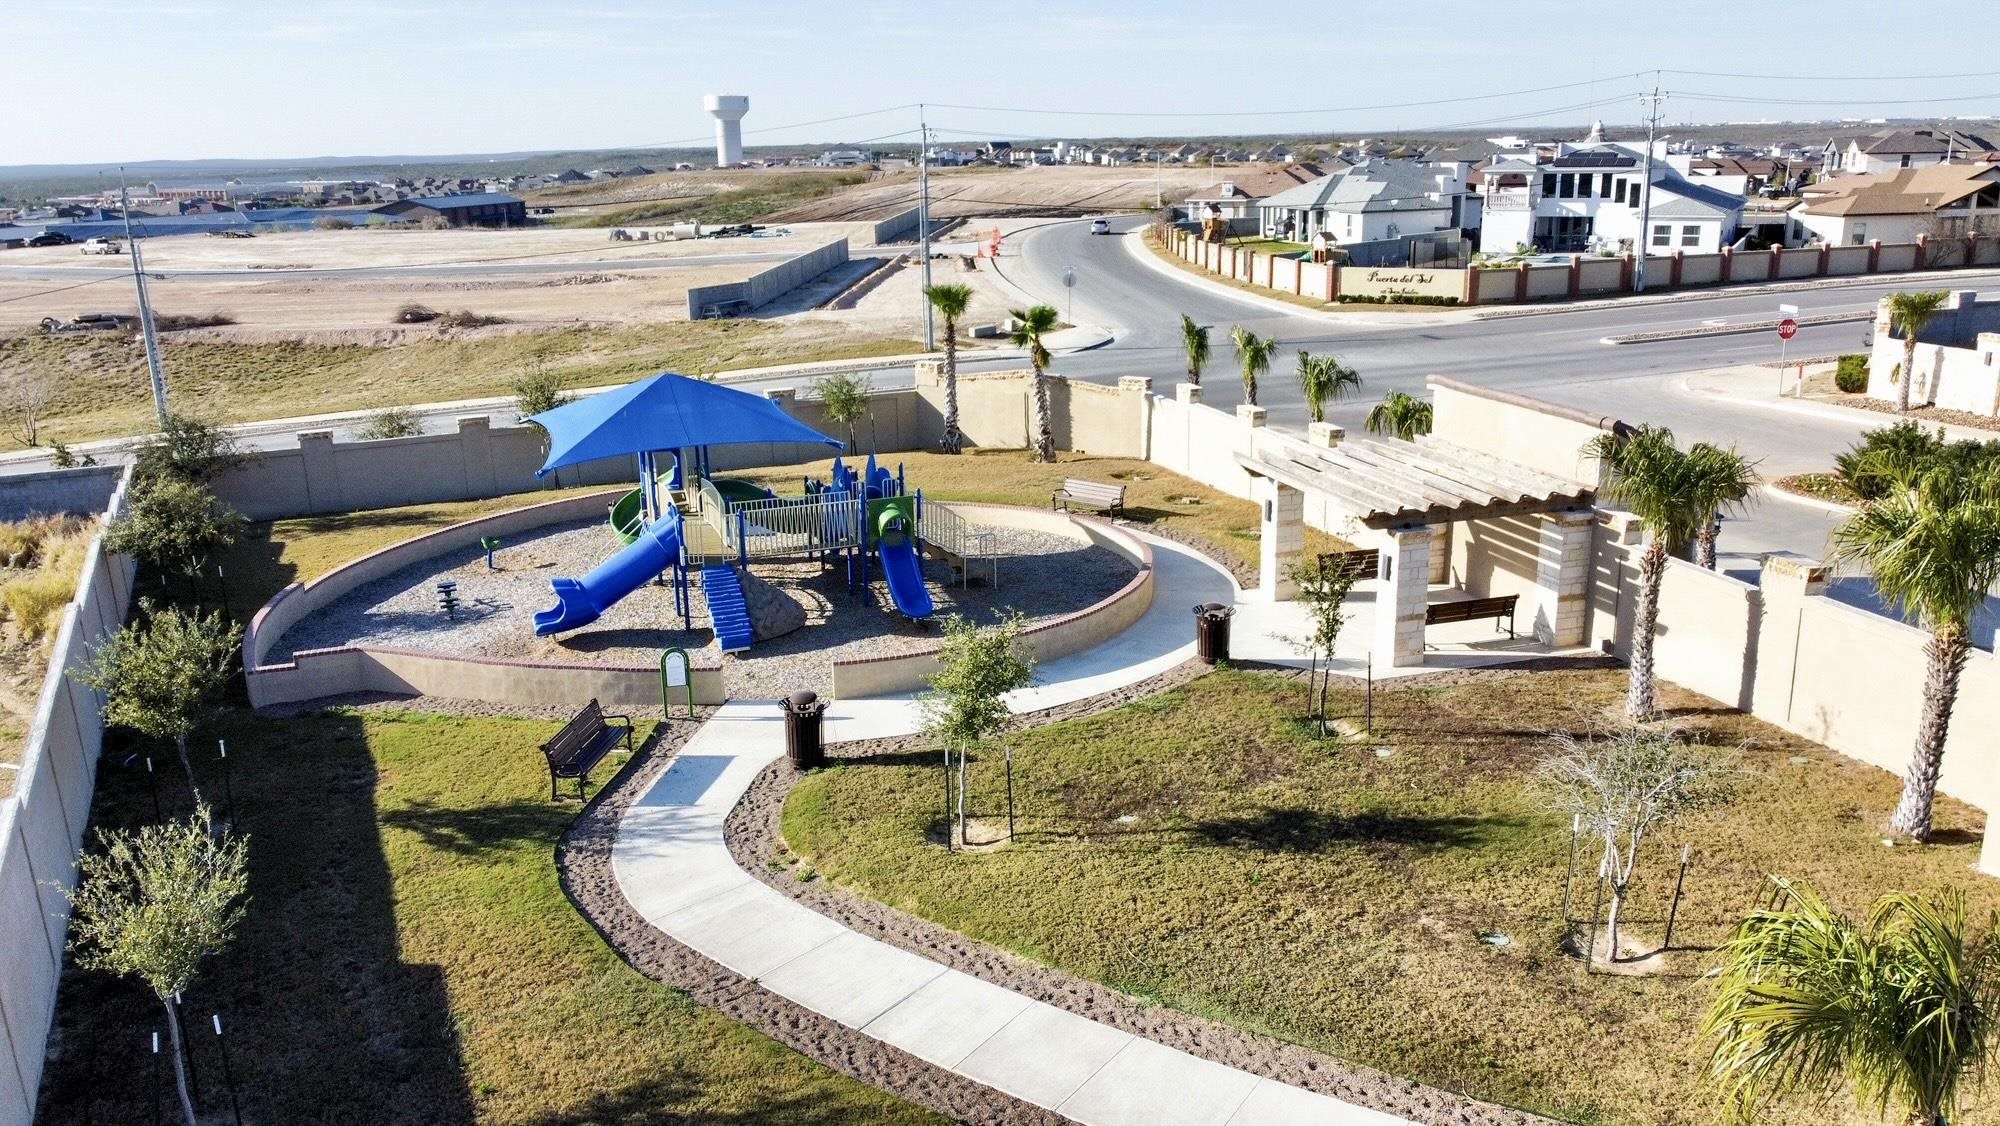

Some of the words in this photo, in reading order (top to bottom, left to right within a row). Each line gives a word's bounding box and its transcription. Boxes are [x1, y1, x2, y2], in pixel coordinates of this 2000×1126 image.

[1367, 271, 1398, 283] Puerta
[1400, 274, 1414, 283] del
[1416, 273, 1434, 284] Sol
[1779, 324, 1796, 333] STOP
